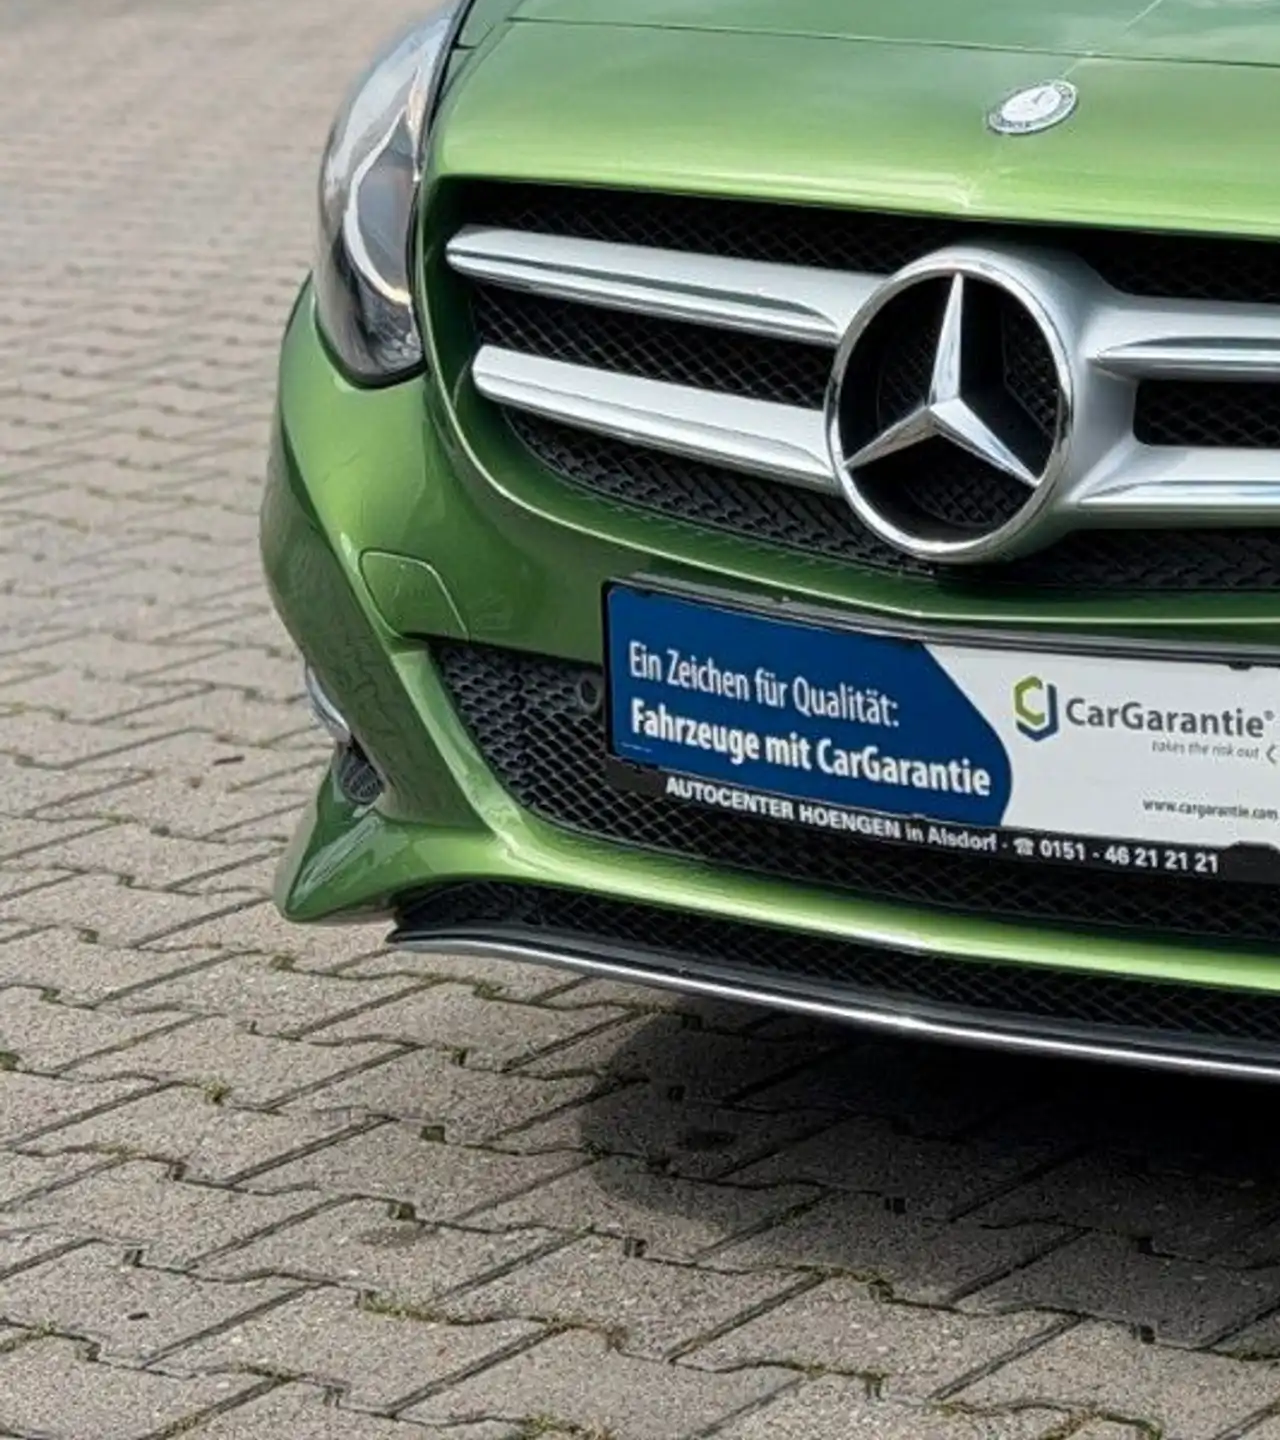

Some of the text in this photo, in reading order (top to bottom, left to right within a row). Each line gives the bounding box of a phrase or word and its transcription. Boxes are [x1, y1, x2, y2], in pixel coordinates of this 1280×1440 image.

[629, 640, 899, 727] Ein Zeichen für Qualität:
[631, 697, 991, 796] Fahrzeuge mit CarGarantie
[666, 777, 794, 820] AUTOCENTER
[799, 804, 901, 839] HOENGEN
[906, 823, 923, 842] in
[928, 825, 997, 852] Alsdorf
[1040, 838, 1085, 861] 0151
[1104, 846, 1129, 865] 46
[1135, 848, 1158, 868] 21
[1165, 851, 1188, 871] 21
[1195, 853, 1219, 874] 21
